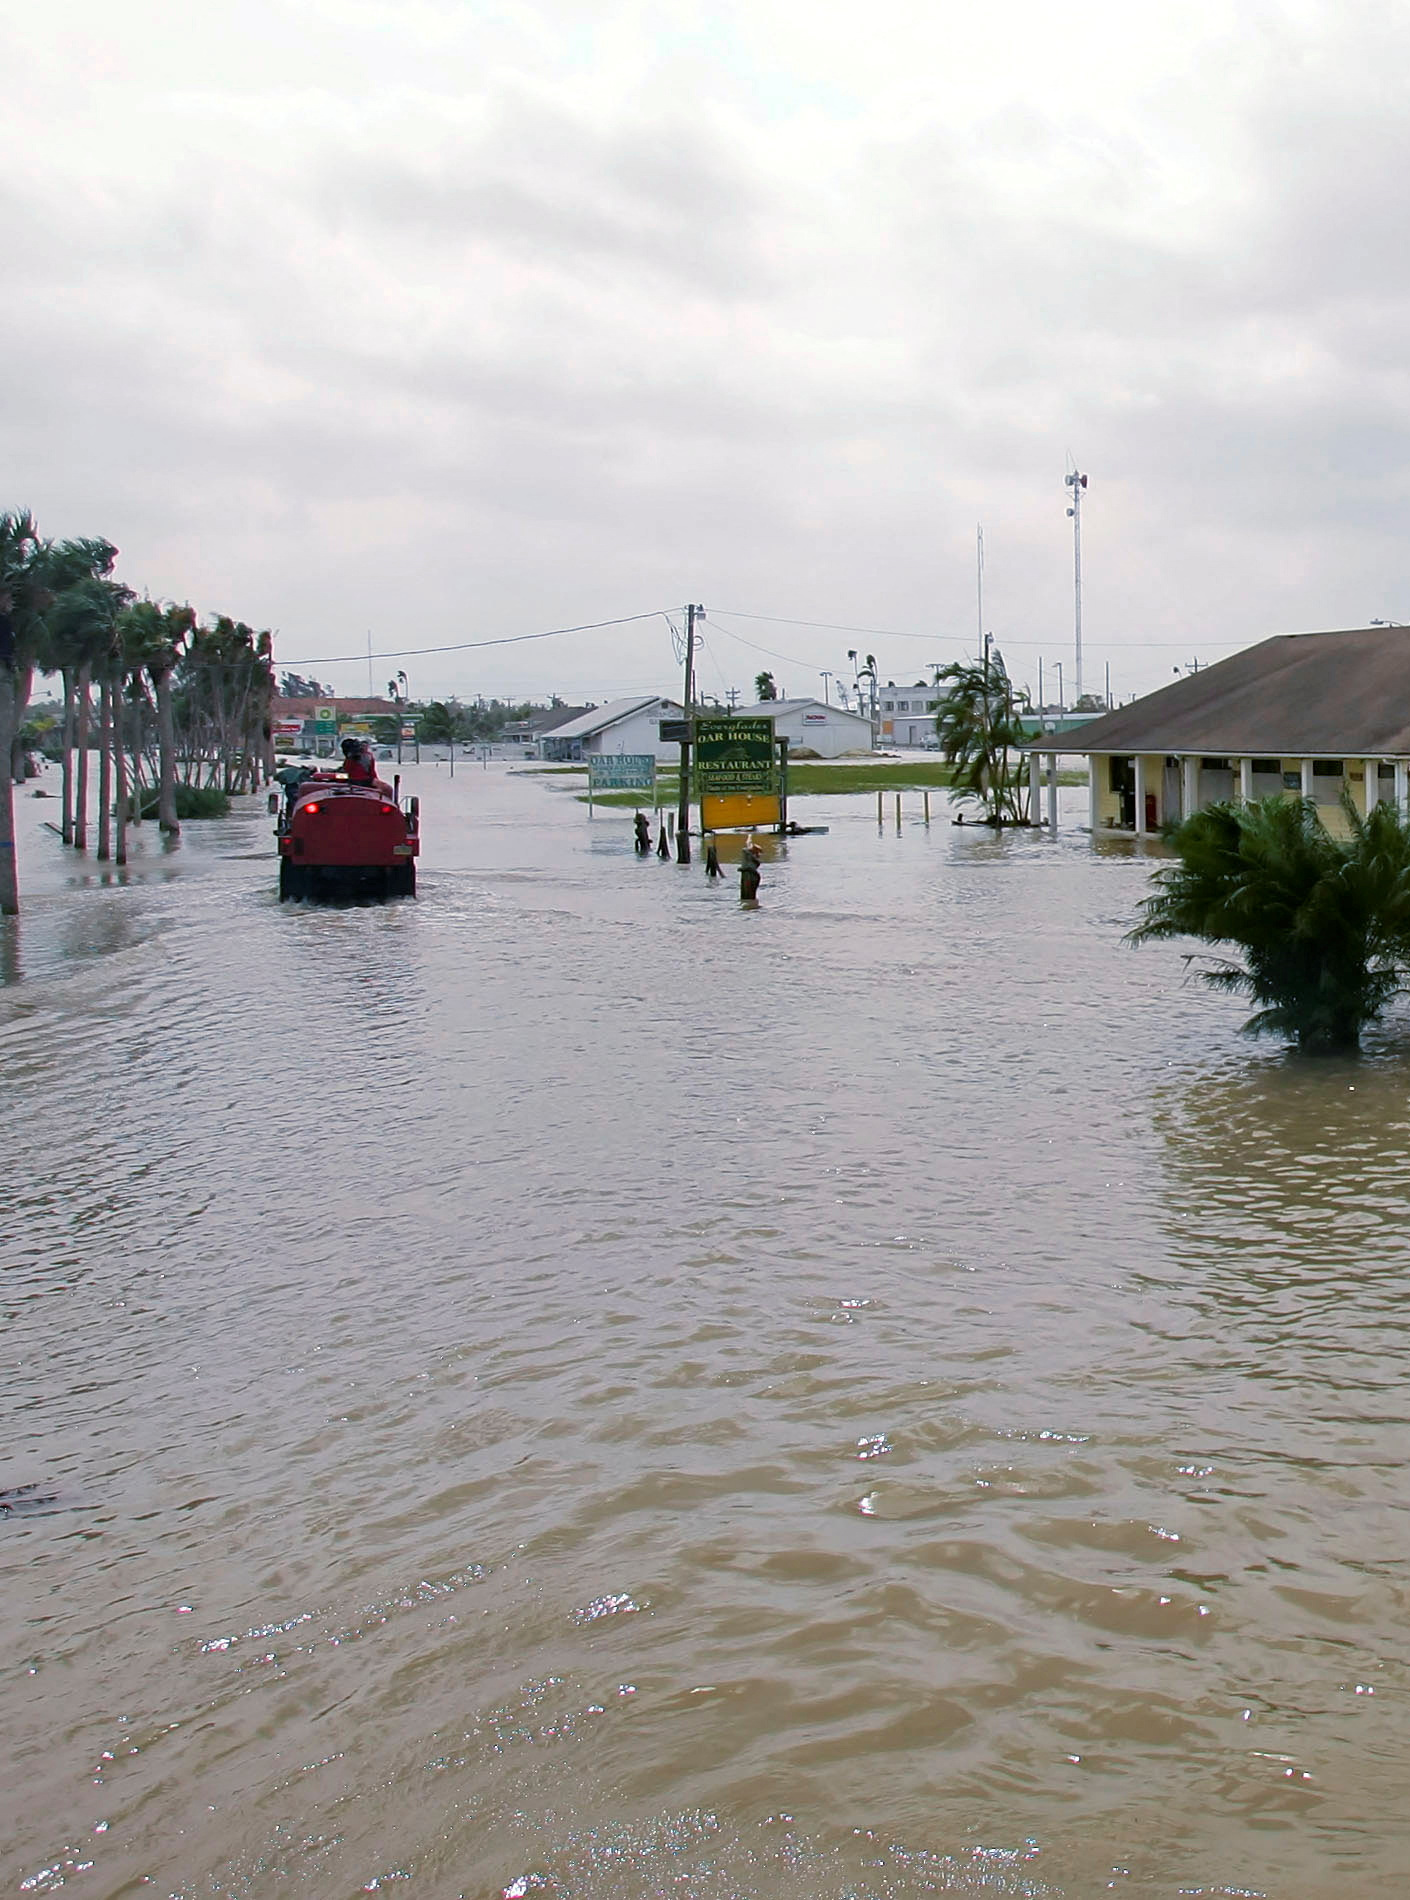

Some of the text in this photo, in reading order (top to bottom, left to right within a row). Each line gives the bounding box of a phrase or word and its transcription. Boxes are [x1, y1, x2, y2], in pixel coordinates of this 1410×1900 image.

[698, 732, 769, 743] OAR HOUSE
[591, 756, 614, 765] OAR
[698, 761, 770, 770] RESTAURANT
[594, 777, 654, 788] PARKING
